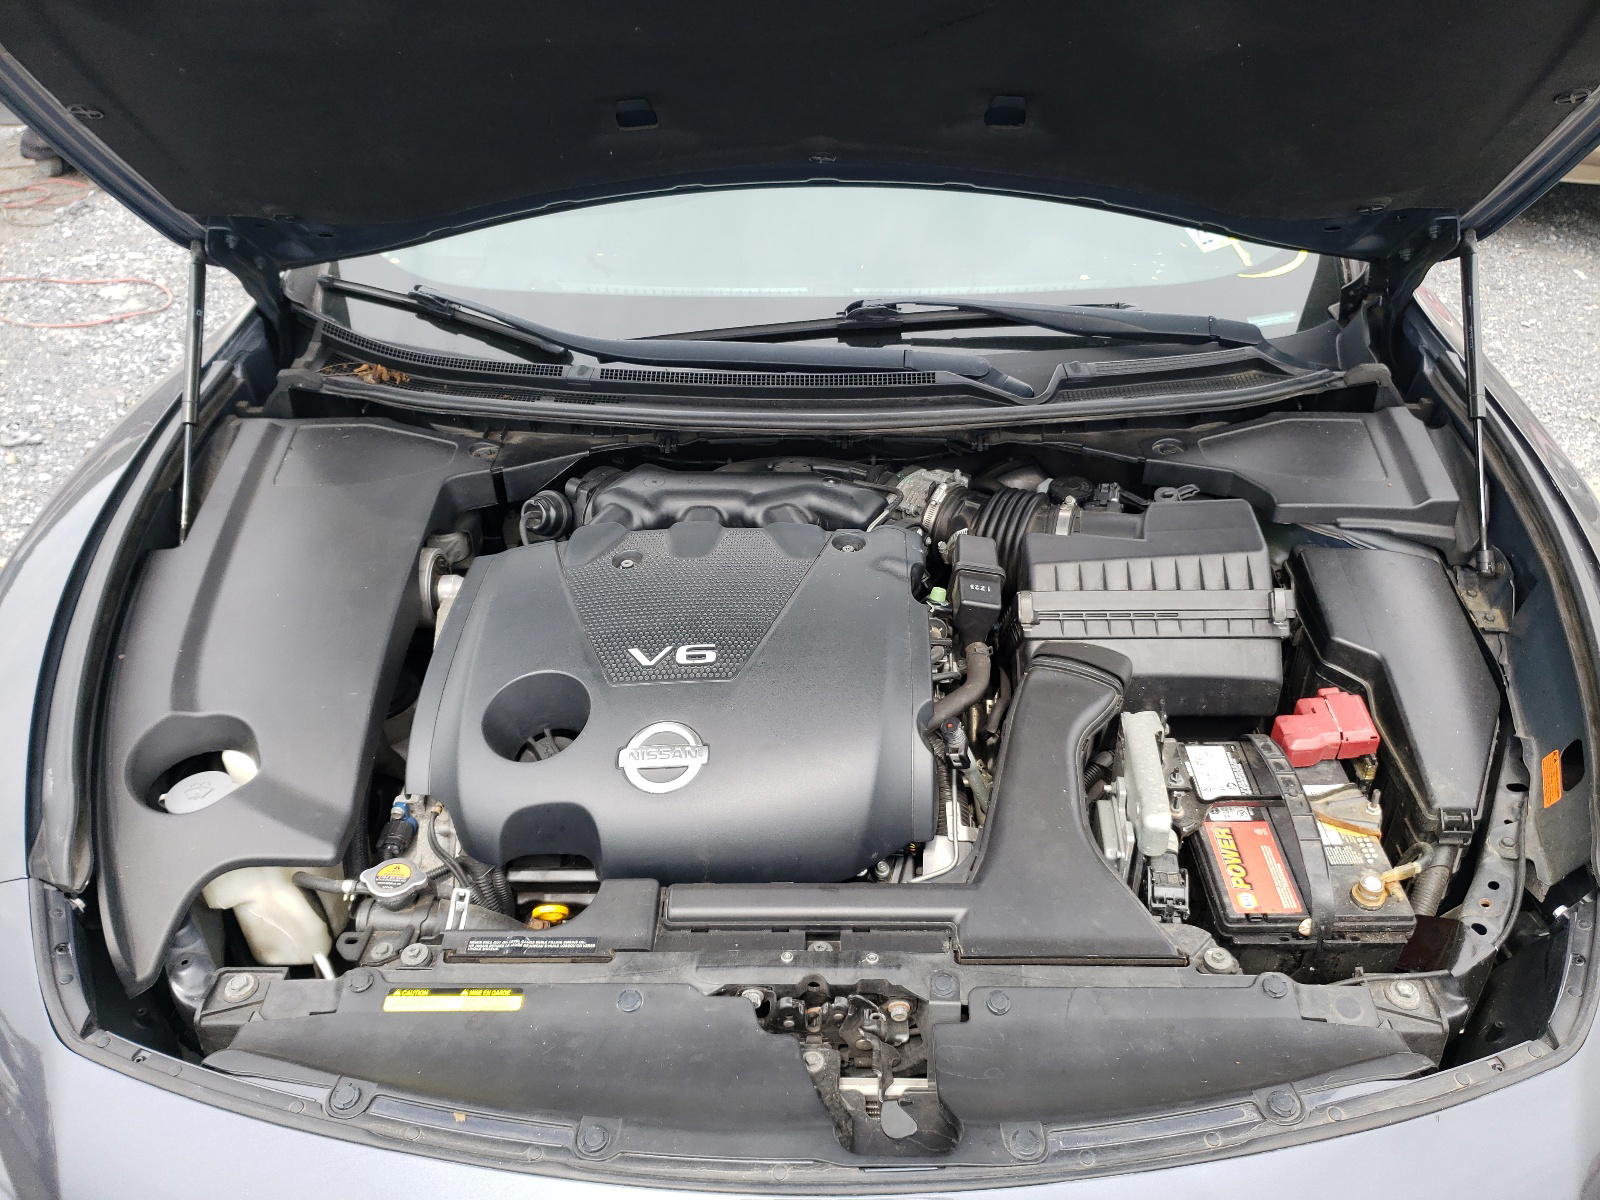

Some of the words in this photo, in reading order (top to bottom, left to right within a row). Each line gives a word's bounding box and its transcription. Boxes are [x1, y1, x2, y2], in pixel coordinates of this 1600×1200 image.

[627, 643, 717, 666] V6
[627, 747, 699, 761] NISSAN
[1212, 826, 1253, 890] POWER
